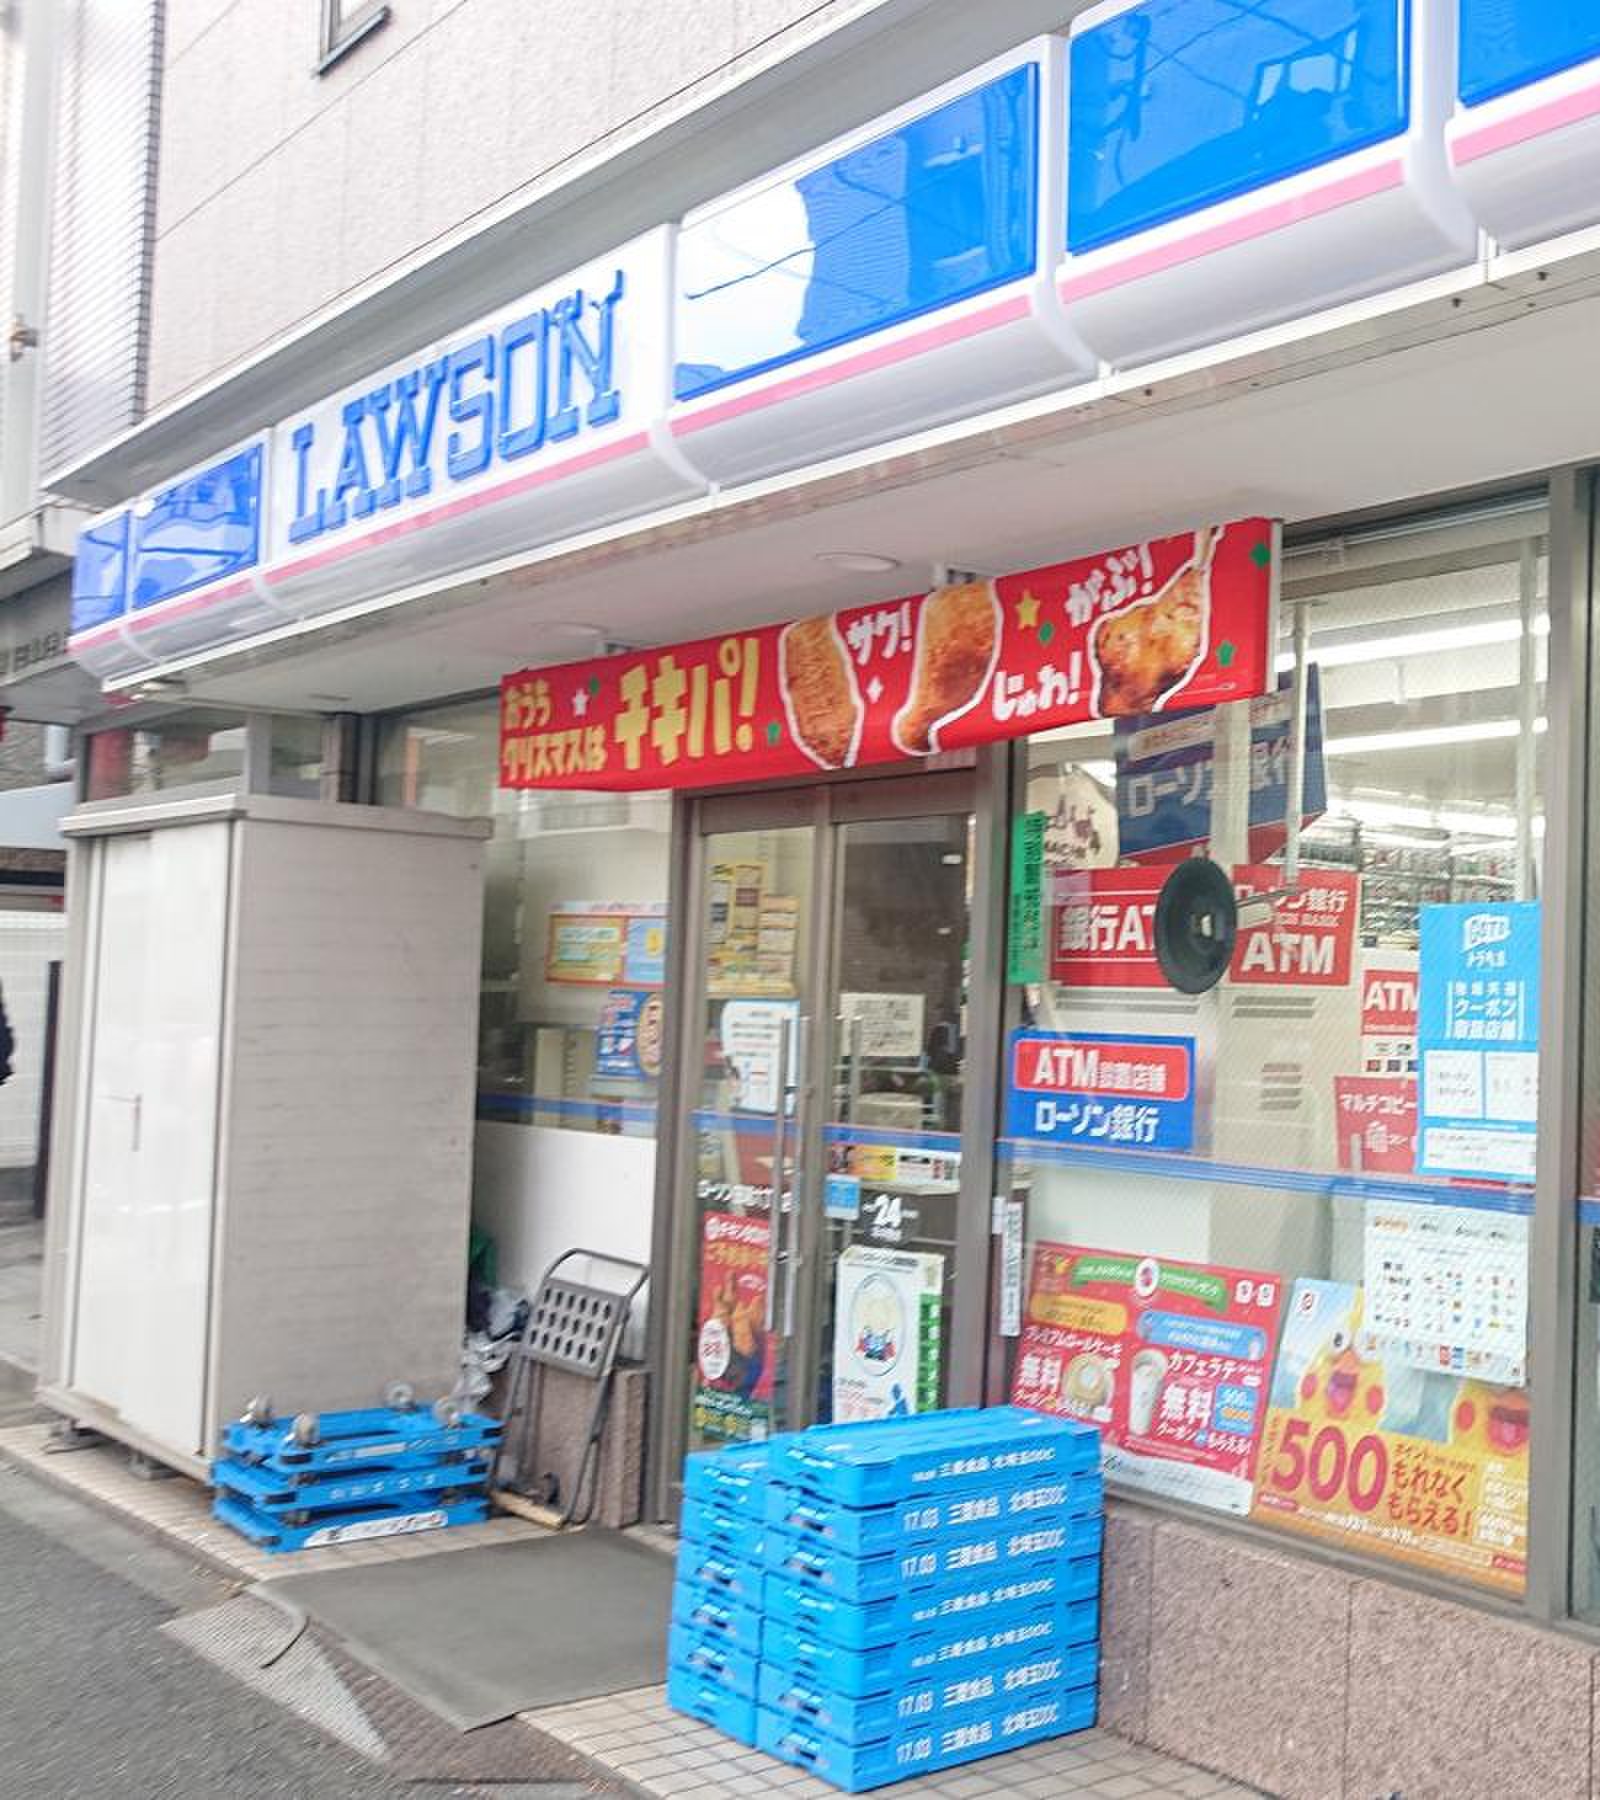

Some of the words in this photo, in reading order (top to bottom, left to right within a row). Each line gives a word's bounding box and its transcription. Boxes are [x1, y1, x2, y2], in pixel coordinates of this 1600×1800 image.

[288, 269, 624, 544] LAWSON
[1065, 543, 1153, 627] がぶ!
[846, 601, 912, 665] サク!
[504, 679, 551, 729] おうち
[614, 637, 760, 770] チキパ!
[991, 650, 1082, 721] じゅわ!
[503, 724, 608, 782] クリスマスは
[1240, 931, 1337, 975] ATM
[1455, 998, 1518, 1018] クーポン
[1035, 1100, 1160, 1143] ローソン銀行
[1167, 1351, 1238, 1380] カフェラテ
[1159, 1382, 1213, 1429] 無料
[1270, 1418, 1388, 1513] 500
[1392, 1461, 1466, 1503] もれなく
[1387, 1495, 1473, 1537] もらえる!
